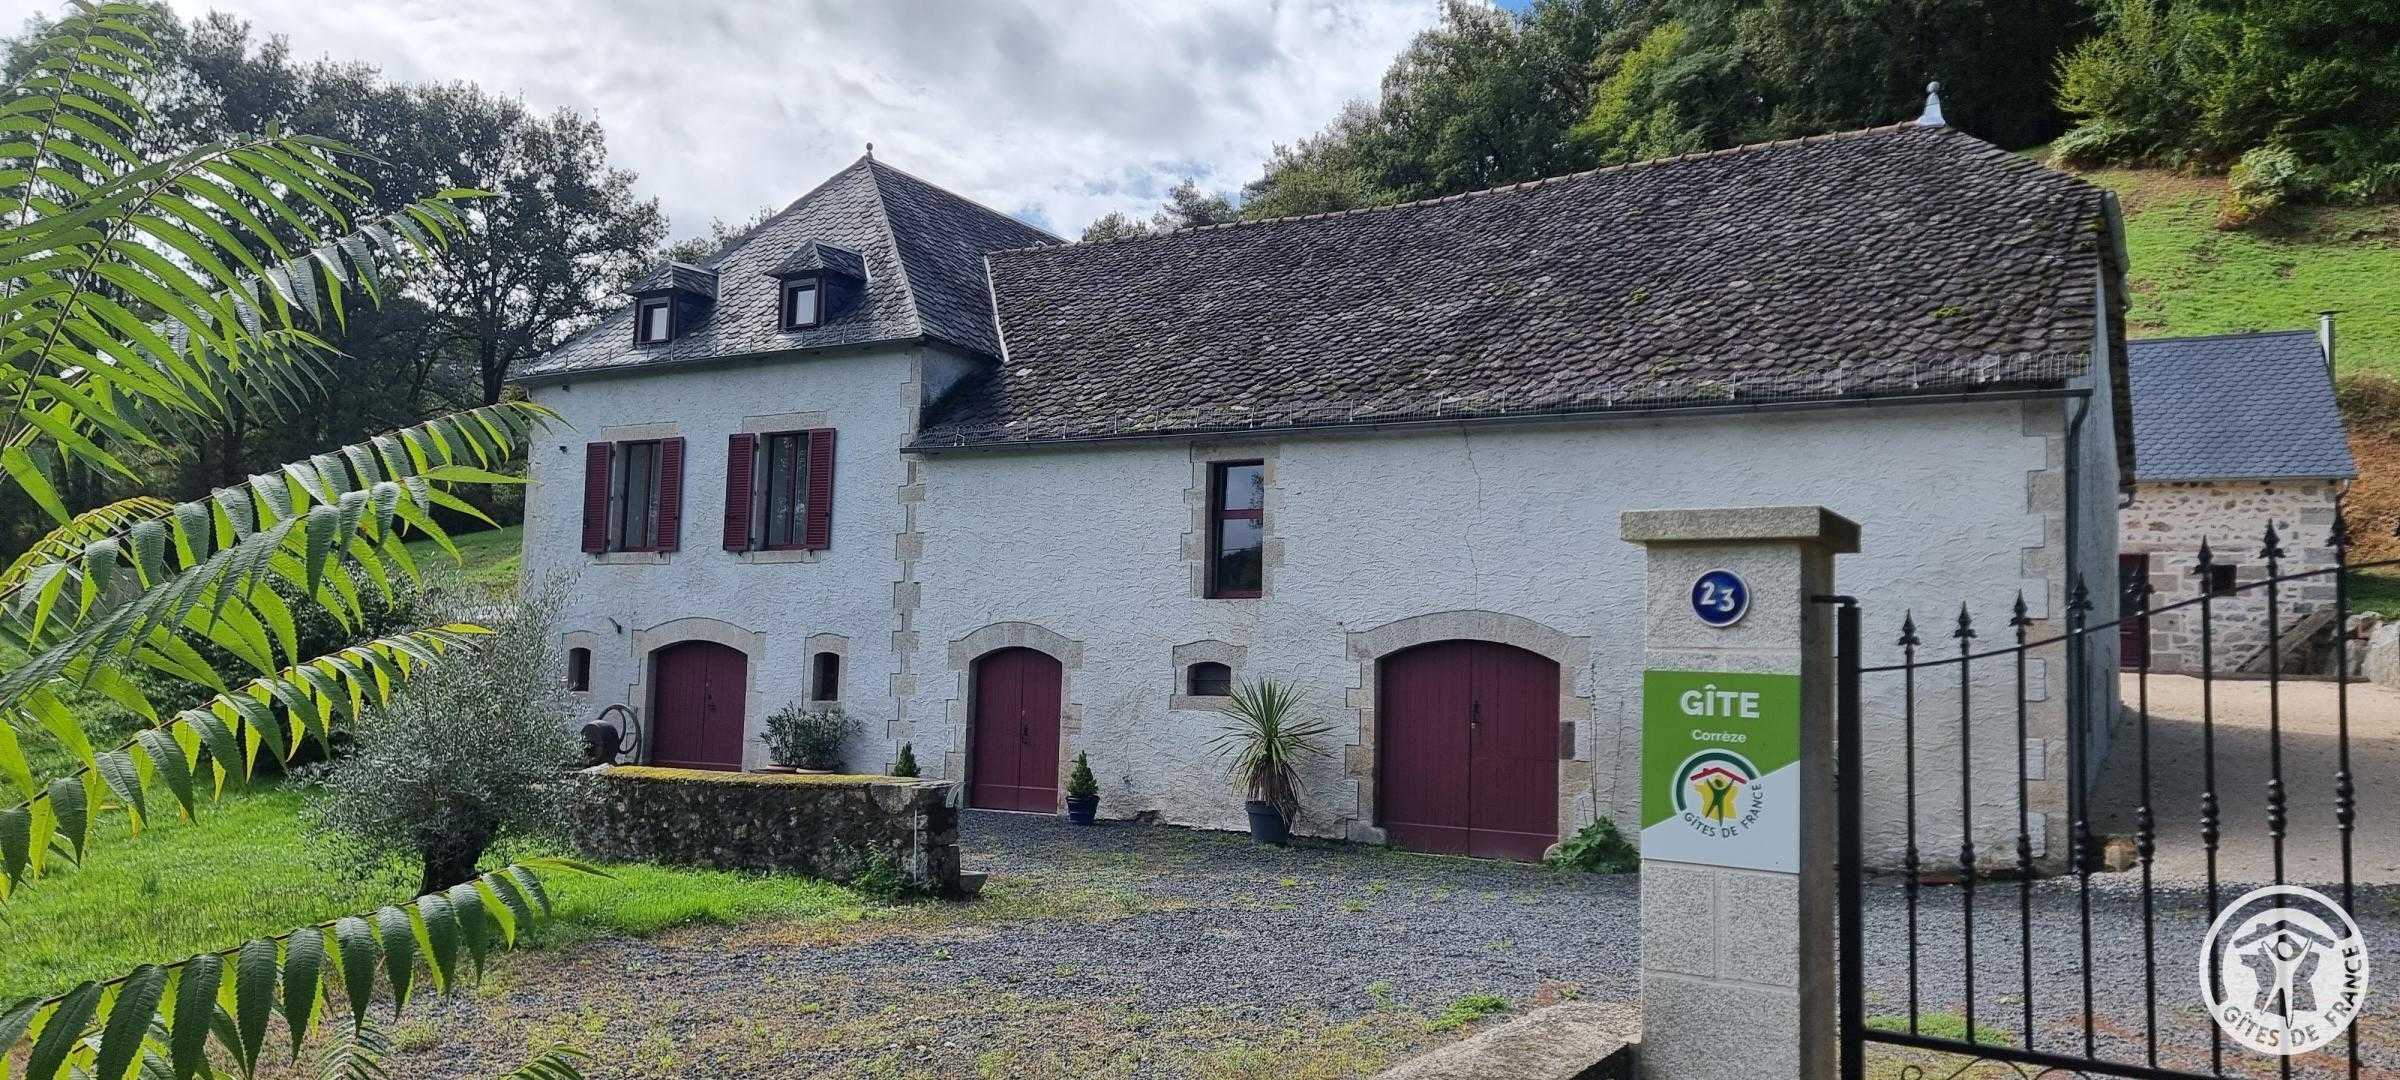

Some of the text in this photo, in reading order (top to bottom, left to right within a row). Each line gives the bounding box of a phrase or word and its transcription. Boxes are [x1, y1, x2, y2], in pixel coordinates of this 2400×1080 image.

[1700, 581, 1735, 612] 23
[1680, 684, 1760, 719] GÎTE
[1692, 729, 1747, 743] Corrèze
[1684, 783, 1763, 838] GÎTES DE FRANCE
